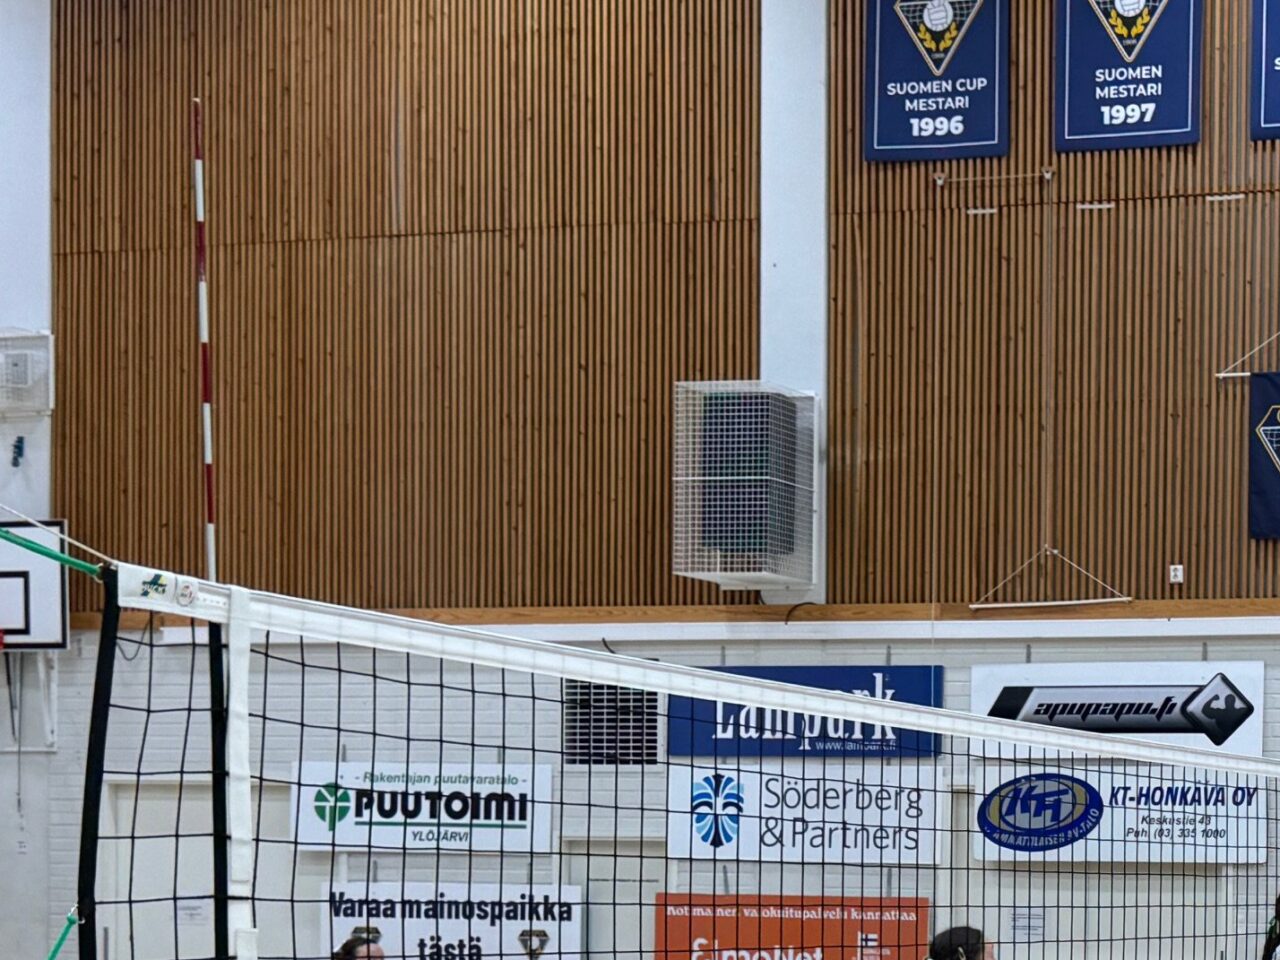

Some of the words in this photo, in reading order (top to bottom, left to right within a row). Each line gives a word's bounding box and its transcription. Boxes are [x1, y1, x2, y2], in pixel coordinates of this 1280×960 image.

[1094, 65, 1163, 82] SUOMEN
[886, 79, 953, 96] SUOMEN
[955, 77, 988, 93] CUP
[1095, 82, 1163, 100] MESTARI
[904, 96, 970, 112] MESTARI
[1100, 103, 1157, 125] 1997
[909, 115, 965, 137] 1996
[1032, 695, 1178, 722] apupapu.fi
[354, 790, 528, 821] PUUTOIMI
[763, 777, 924, 818] Söderberg
[1109, 786, 1226, 807] KT-HONKAVA
[1231, 786, 1258, 807] OY
[760, 816, 785, 848] &
[792, 817, 920, 851] Partners
[330, 891, 396, 919] Varaa
[401, 892, 573, 927] mainospaikka
